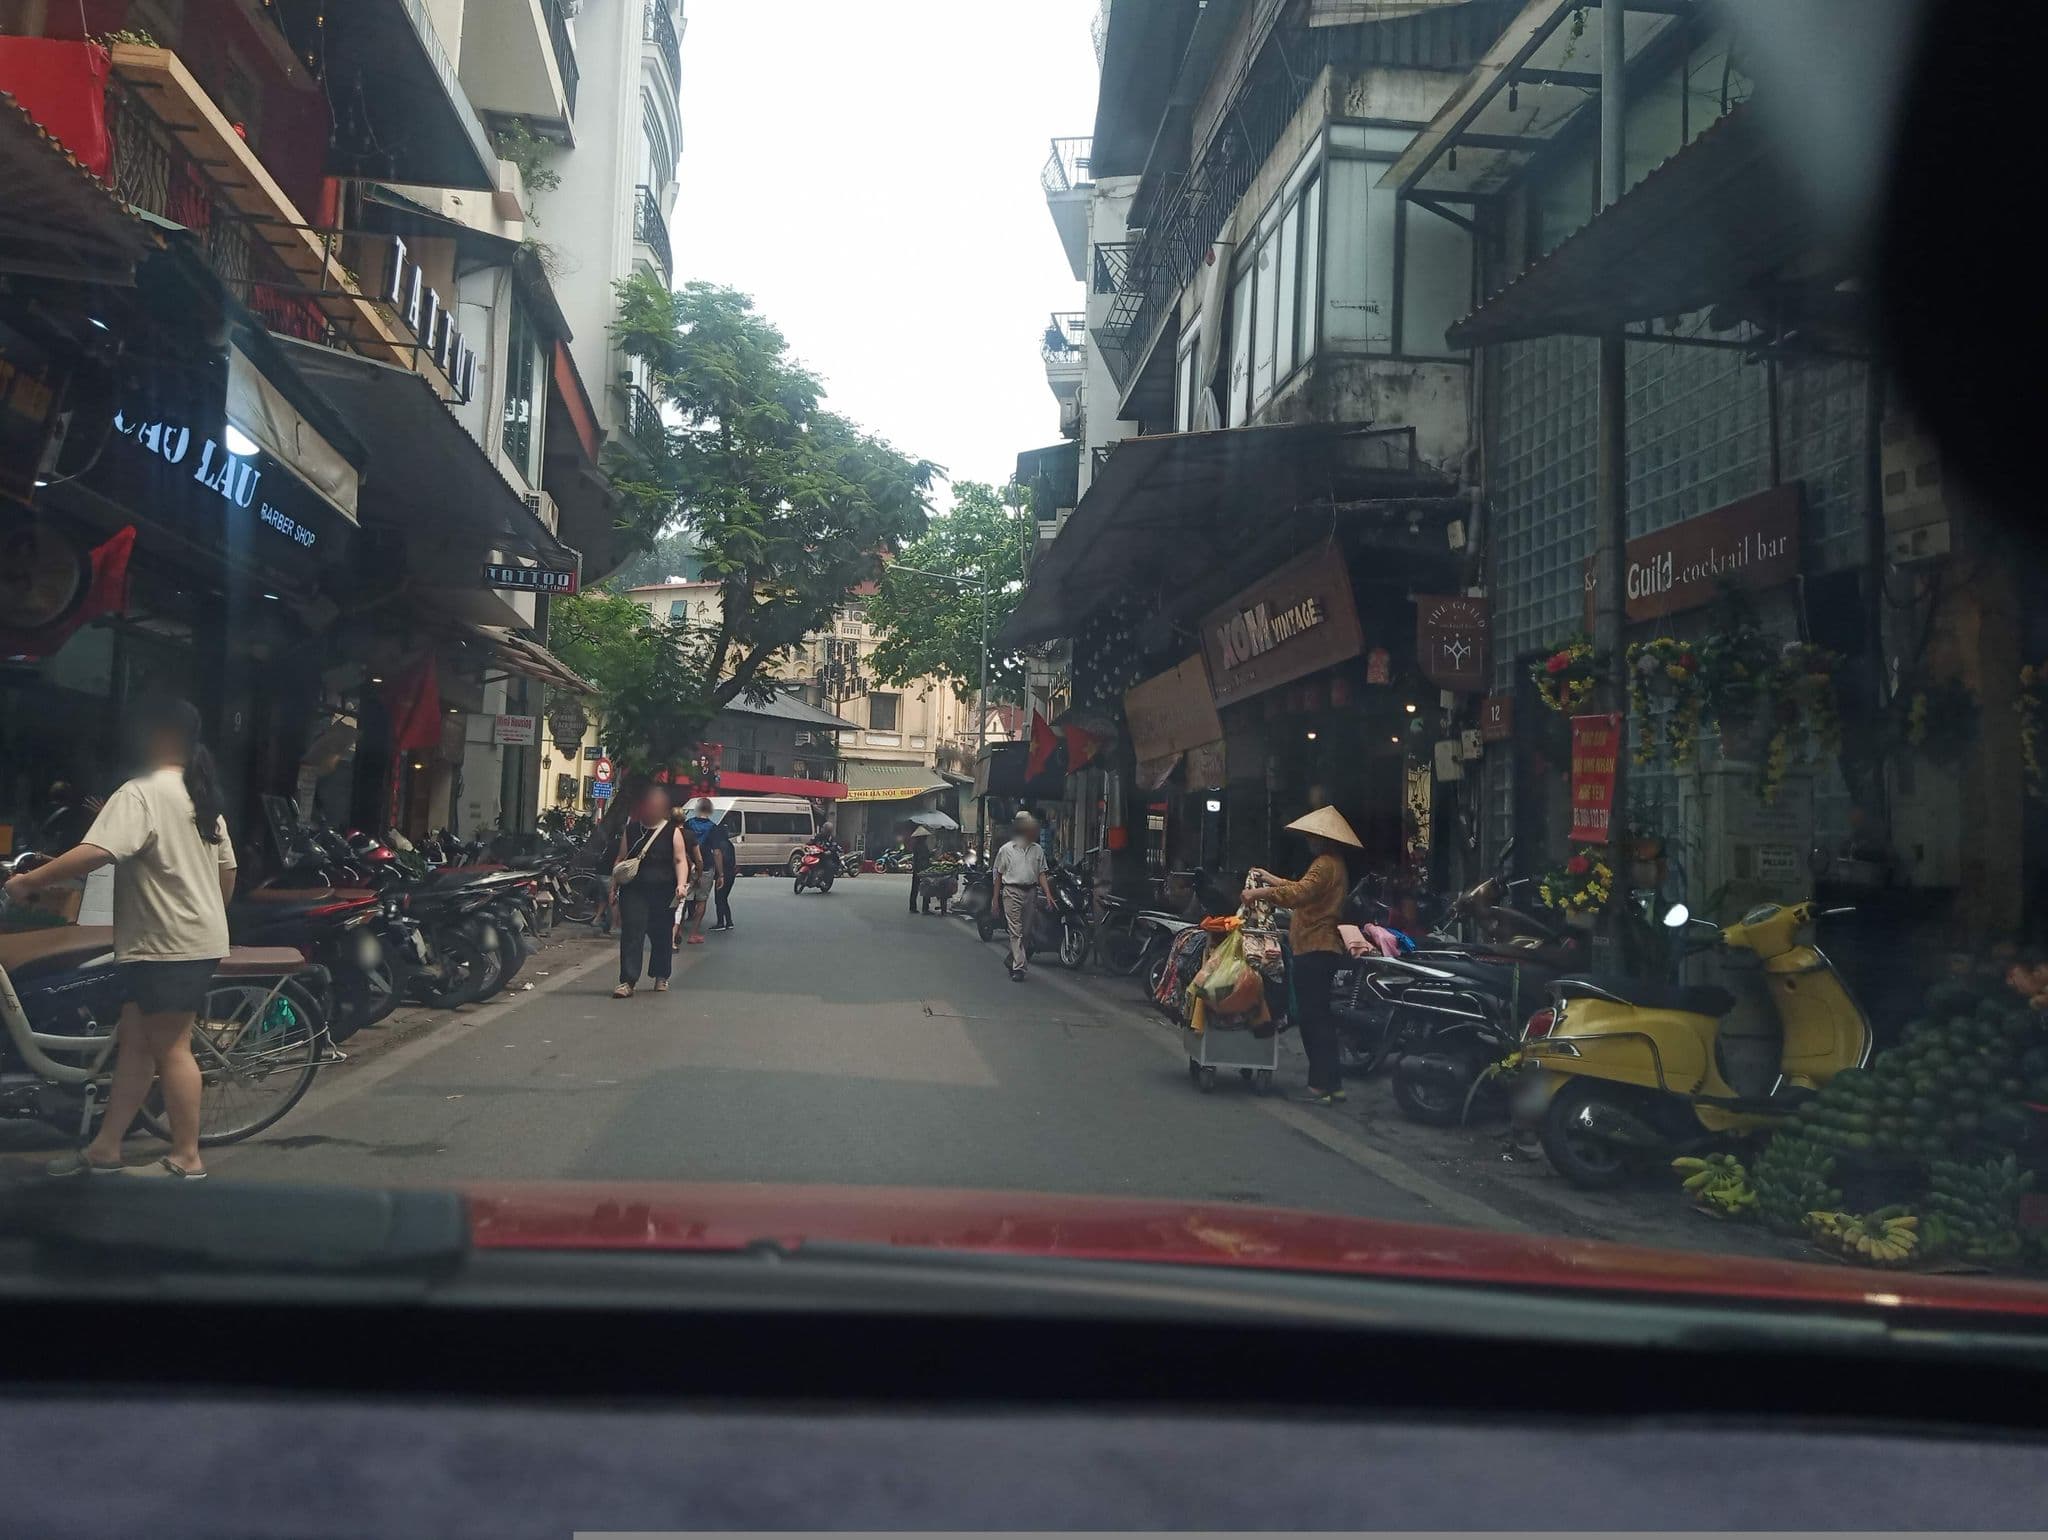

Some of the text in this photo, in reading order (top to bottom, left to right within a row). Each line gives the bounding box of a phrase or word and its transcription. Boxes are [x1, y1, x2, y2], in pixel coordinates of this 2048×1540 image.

[391, 235, 478, 402] TATTOO
[194, 439, 262, 508] LAU
[260, 502, 317, 548] BARBER SHOP
[488, 567, 570, 587] TATTOO
[1627, 551, 1674, 600] Guild
[1757, 532, 1788, 561] bar
[1270, 598, 1319, 643] VINTAGE
[1428, 604, 1448, 626] THE
[1491, 704, 1502, 721] 12
